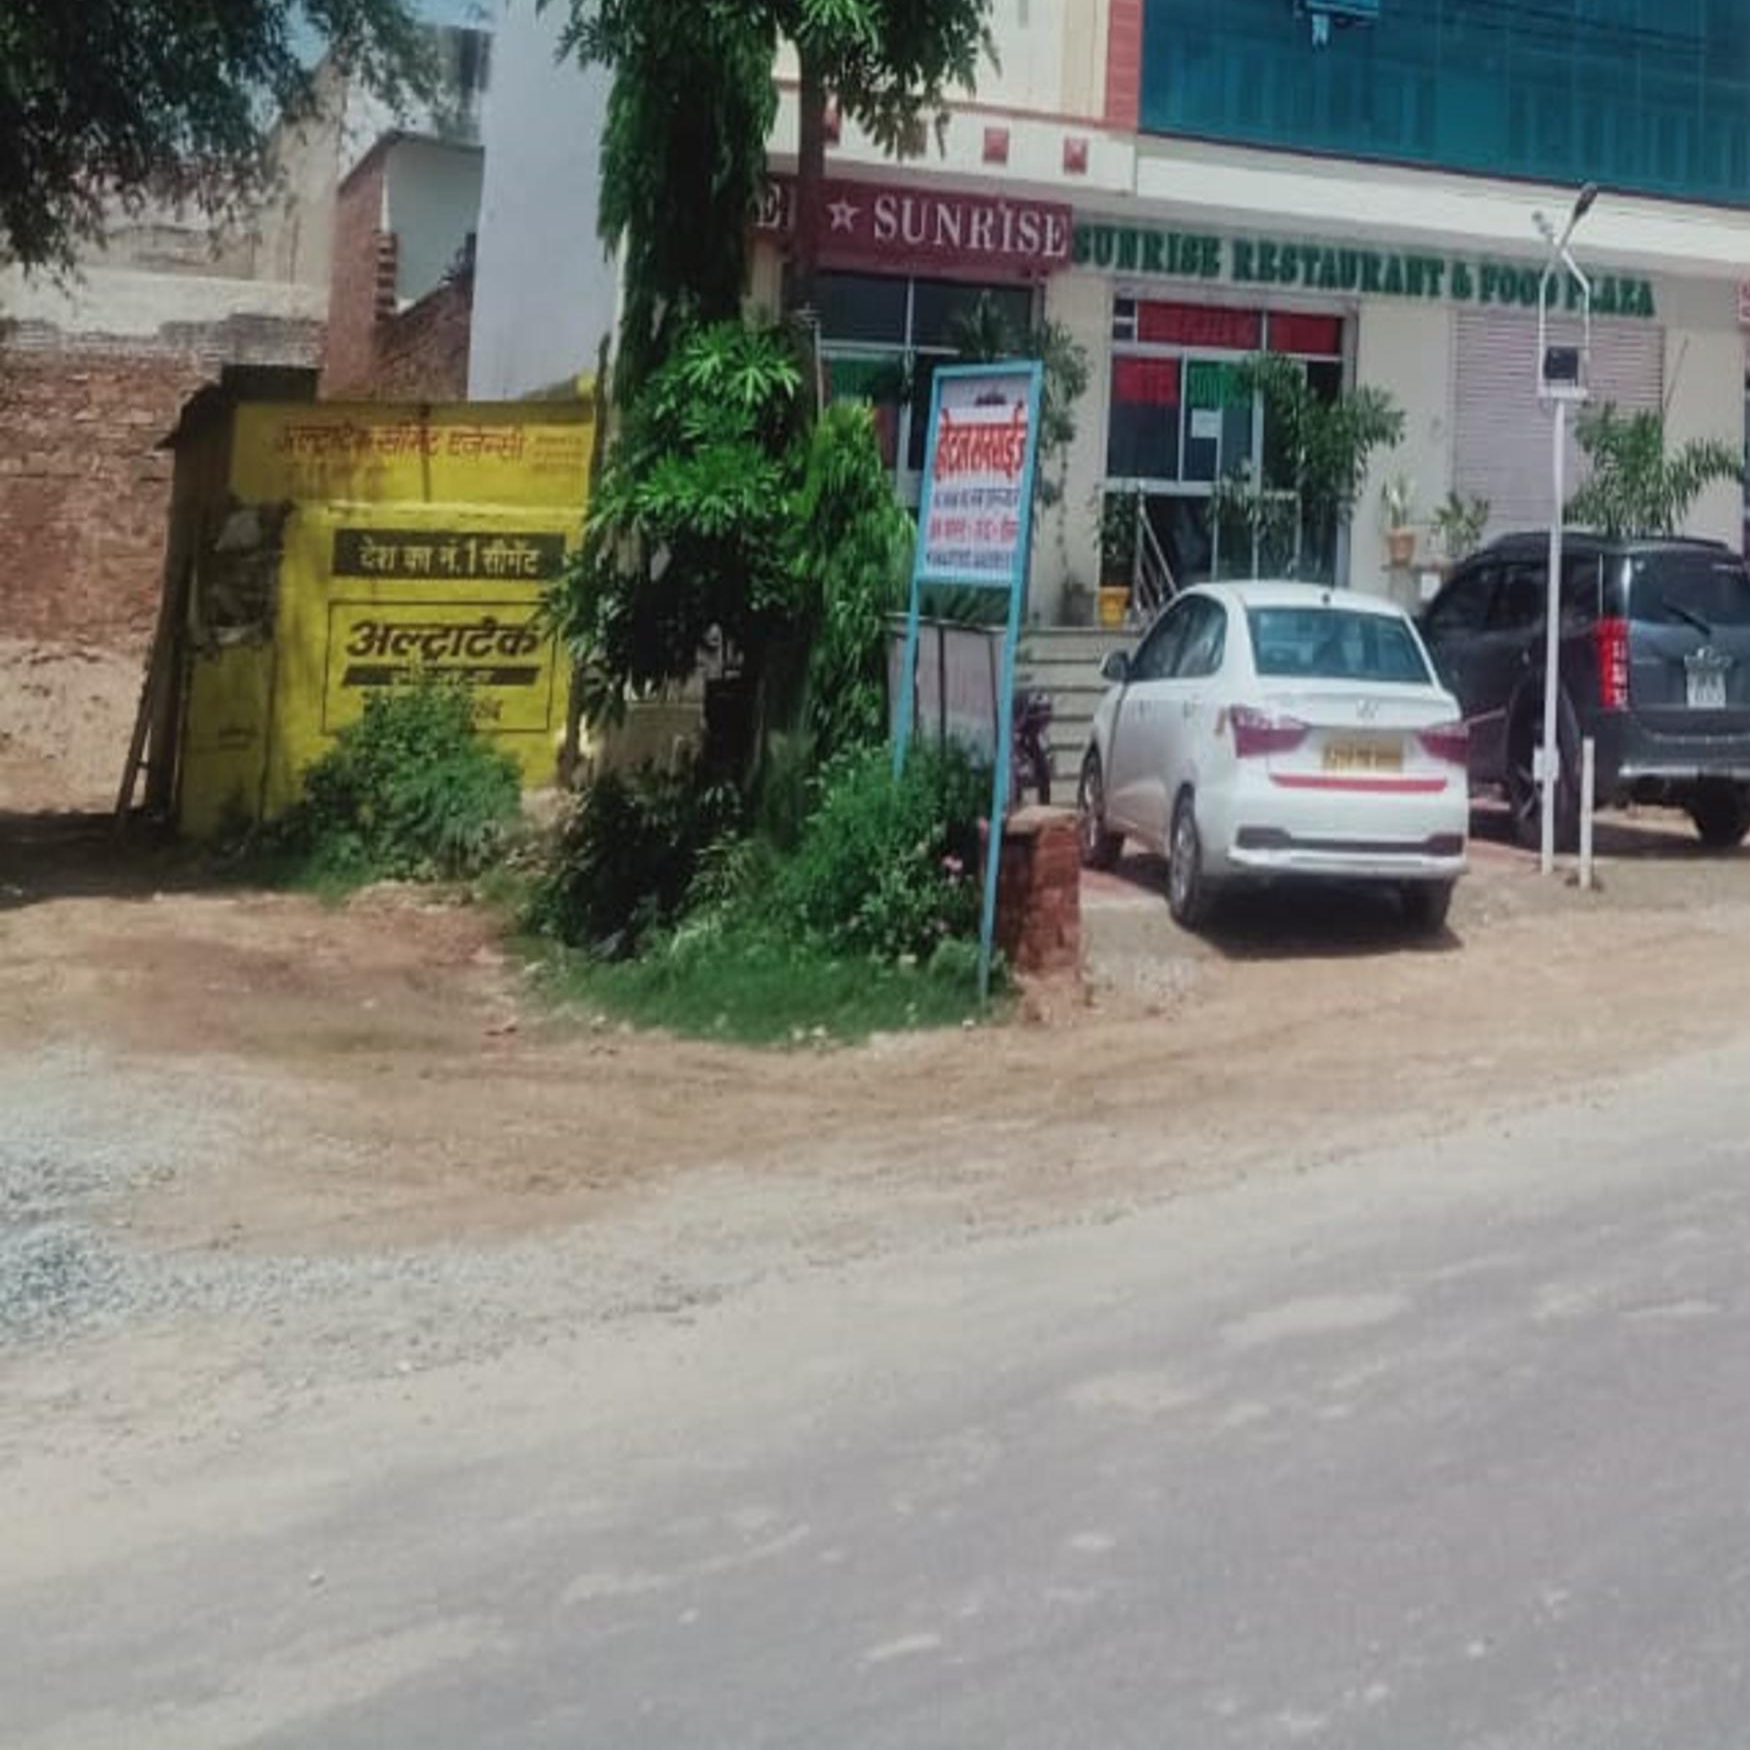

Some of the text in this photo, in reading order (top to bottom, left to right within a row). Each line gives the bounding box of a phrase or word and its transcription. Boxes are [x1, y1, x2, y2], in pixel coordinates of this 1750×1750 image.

[873, 194, 1068, 257] SUNRISE
[1072, 225, 1221, 277] SUNRISE
[1232, 239, 1444, 297] RESTAURANT
[359, 535, 396, 571] देश
[403, 546, 432, 573] का
[346, 615, 540, 662] अल्ट्राटेक
